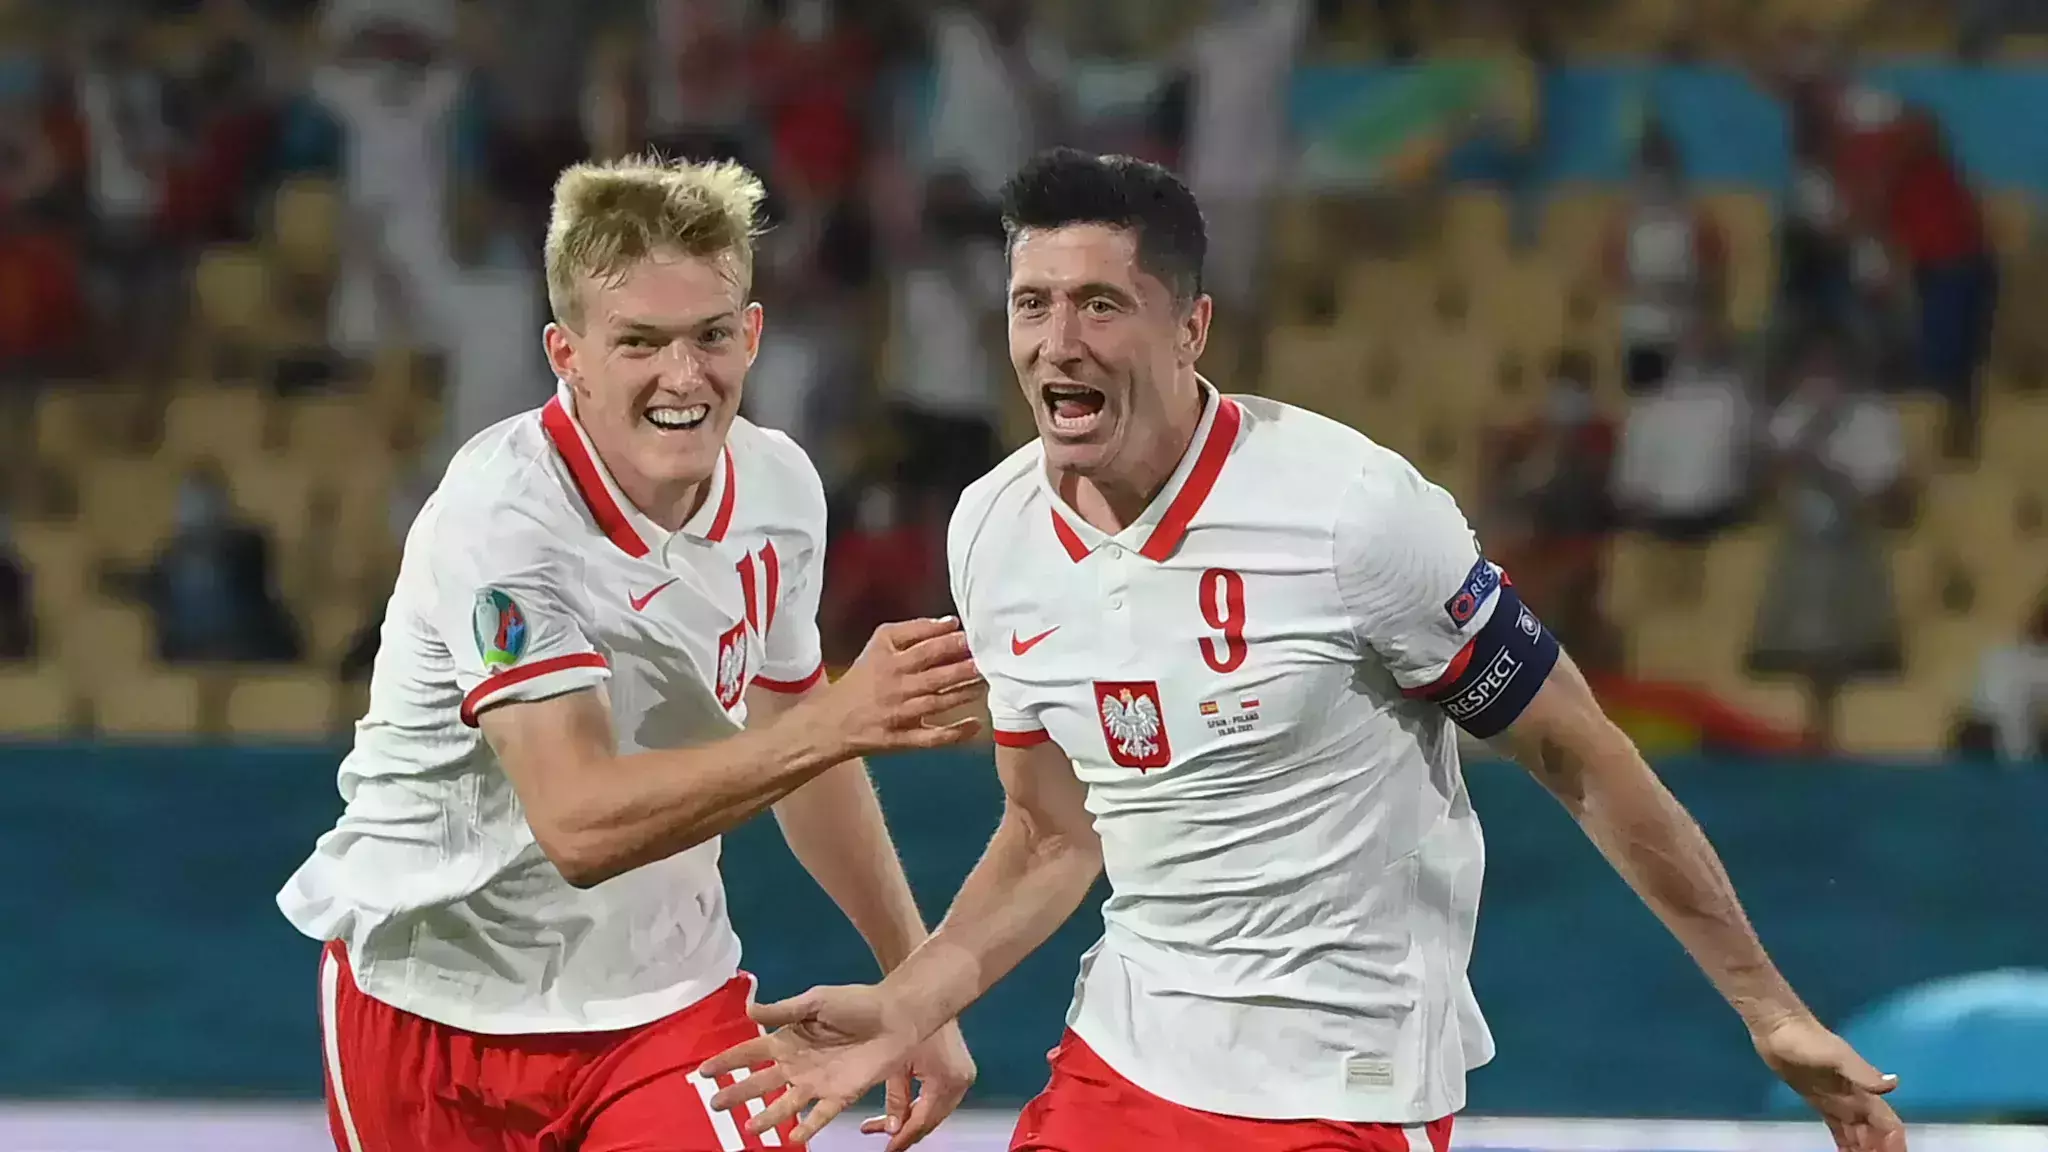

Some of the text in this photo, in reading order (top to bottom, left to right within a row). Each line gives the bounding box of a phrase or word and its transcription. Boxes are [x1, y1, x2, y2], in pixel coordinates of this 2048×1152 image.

[736, 538, 778, 639] 11
[1198, 567, 1248, 673] 9
[1448, 650, 1516, 716] RESPECT
